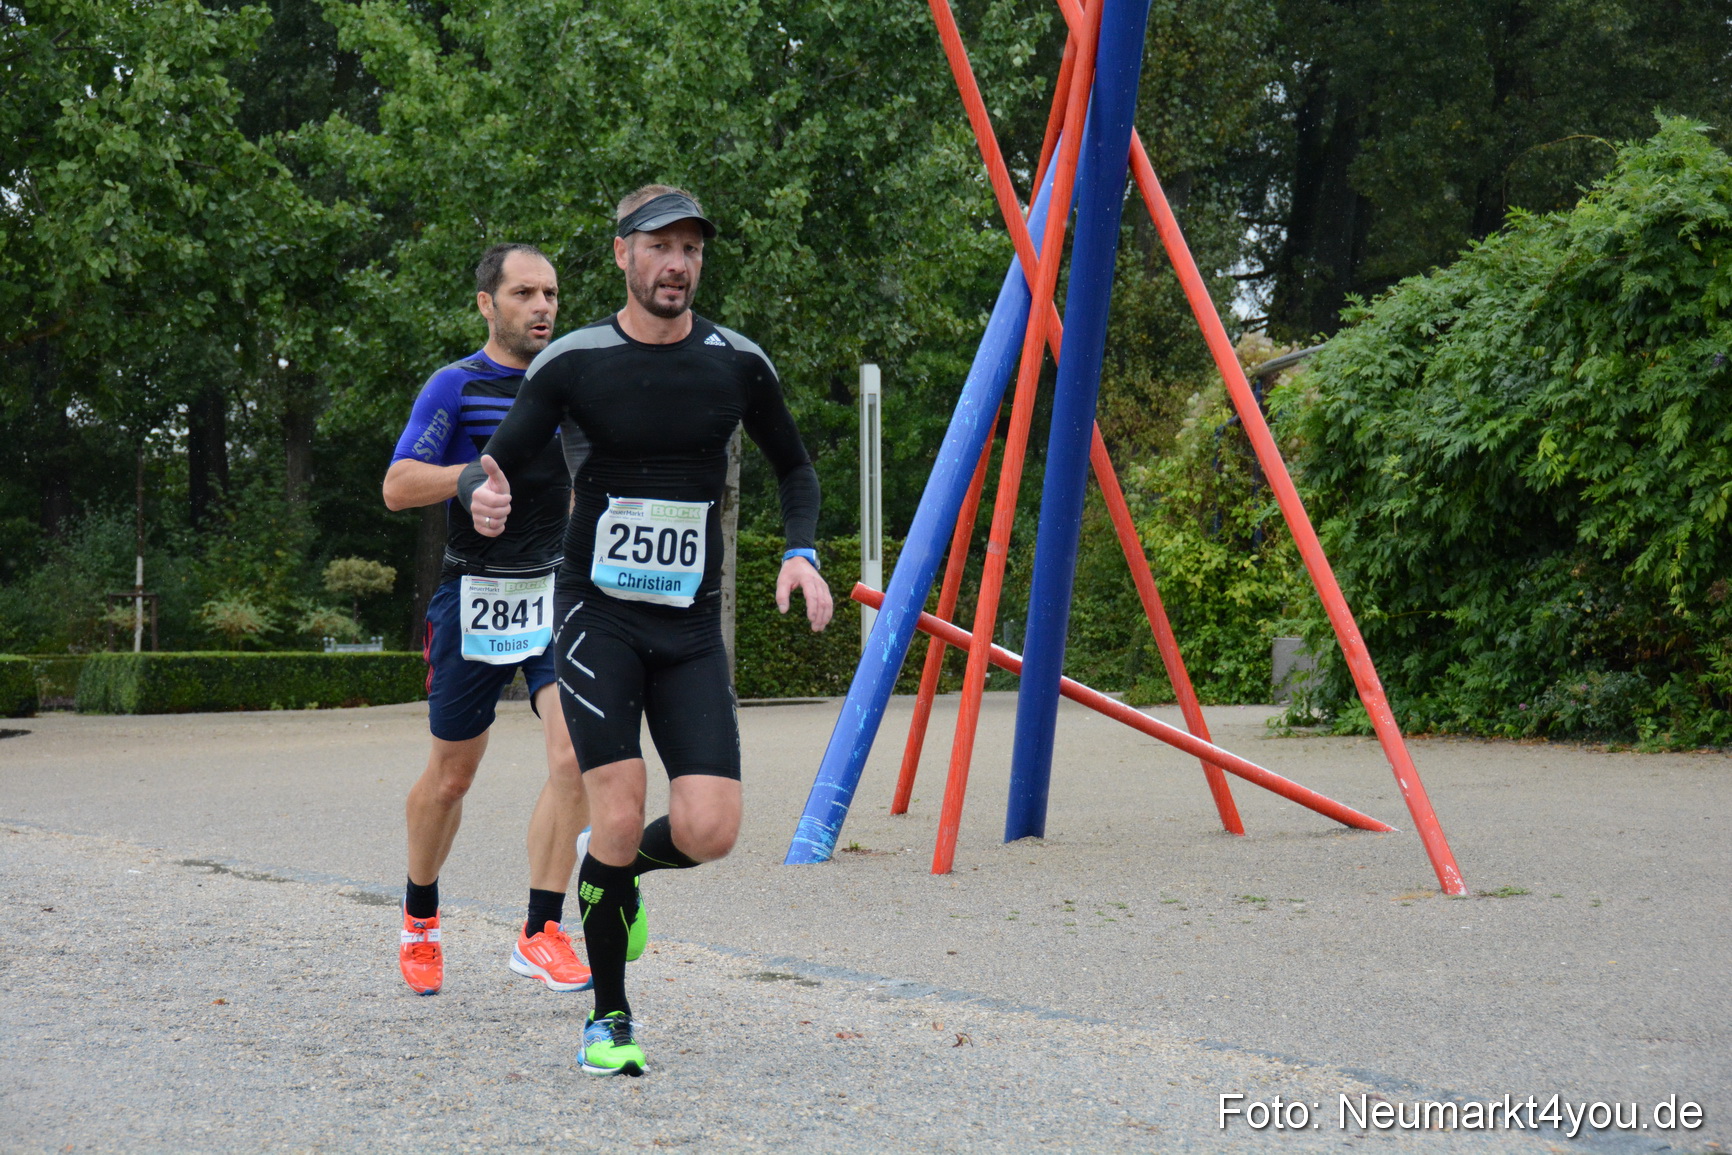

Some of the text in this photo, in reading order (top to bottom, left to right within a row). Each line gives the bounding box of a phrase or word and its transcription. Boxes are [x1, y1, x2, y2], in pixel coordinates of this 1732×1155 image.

[651, 504, 701, 520] BOCK
[607, 523, 698, 567] 2506
[505, 578, 548, 593] BOCK
[617, 572, 681, 592] Christian
[471, 596, 544, 631] 2841
[489, 639, 529, 653] Tobias
